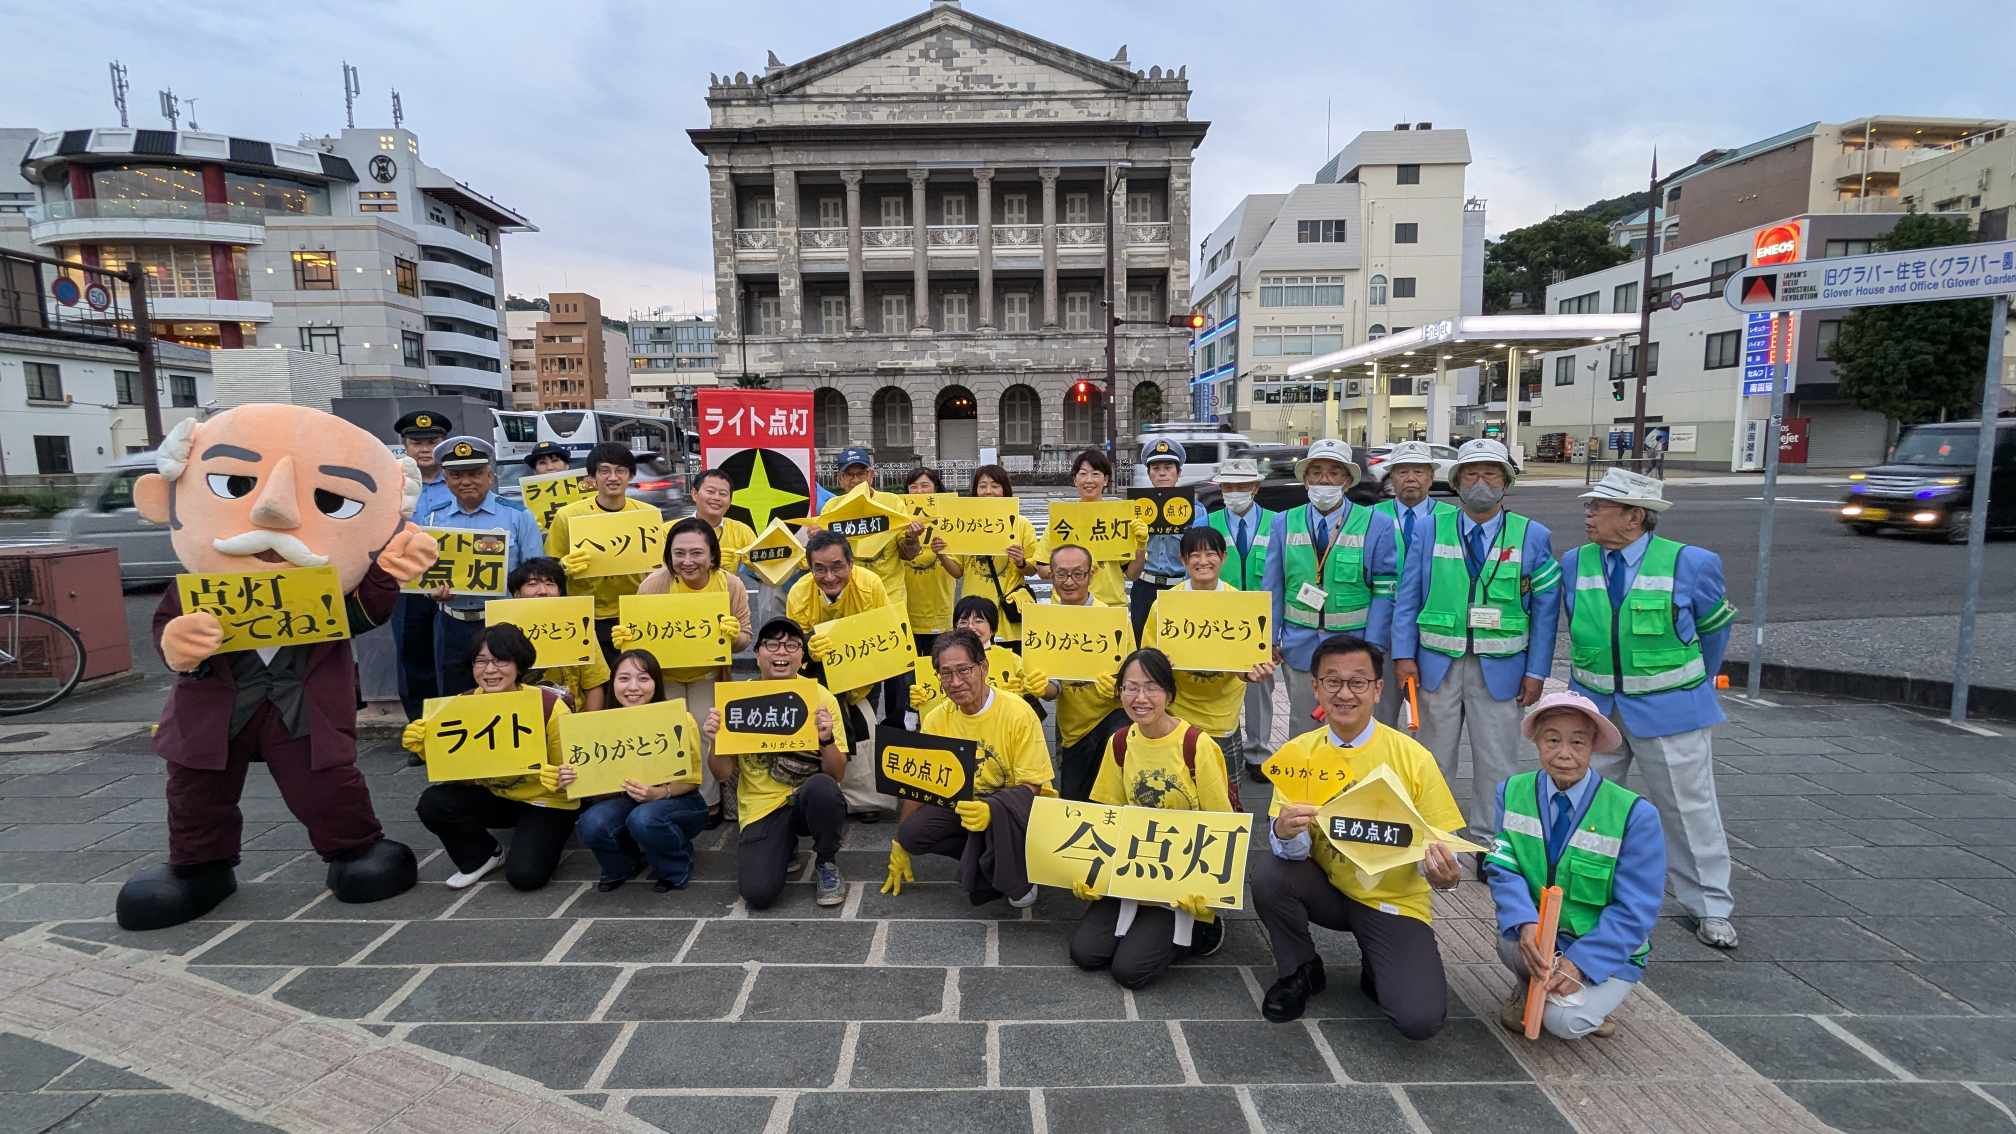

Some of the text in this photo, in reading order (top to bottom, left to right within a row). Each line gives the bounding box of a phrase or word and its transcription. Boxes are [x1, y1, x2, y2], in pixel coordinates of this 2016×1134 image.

[1757, 241, 1794, 258] ENEOS
[1824, 252, 2016, 286] 旧グラバー住宅(グラバー園
[1823, 287, 1852, 299] Glover
[1856, 285, 1884, 296] House
[1888, 283, 1907, 294] and
[1909, 279, 1939, 291] Office
[1942, 276, 1982, 290] (Glover
[705, 407, 808, 436] ライト点灯
[526, 479, 577, 500] ライト
[1134, 503, 1188, 519] 早め 点灯
[575, 526, 661, 557] ヘッド
[941, 515, 1016, 539] ありがとう!
[1054, 518, 1131, 542] 今、点灯
[437, 533, 472, 552] イト
[752, 547, 785, 560] 早め点灯
[419, 559, 503, 590] 点灯
[190, 575, 287, 616] 点灯
[221, 594, 337, 643] てね!
[520, 616, 590, 646] がとう!
[626, 613, 726, 645] ありがとう!
[1160, 615, 1266, 650] ありがとう!
[826, 622, 912, 666] ありがとう!
[1023, 629, 1122, 662] ありがとう!
[728, 707, 798, 728] 早め点灯
[437, 713, 533, 754] ライト
[569, 724, 687, 767] ありがとう!
[760, 740, 806, 749] ありがとう
[885, 752, 953, 787] 早め点灯
[1270, 765, 1346, 781] ありがとう
[1065, 805, 1118, 826] いま
[1333, 819, 1400, 845] 早め点灯
[1053, 820, 1249, 889] 今点灯
